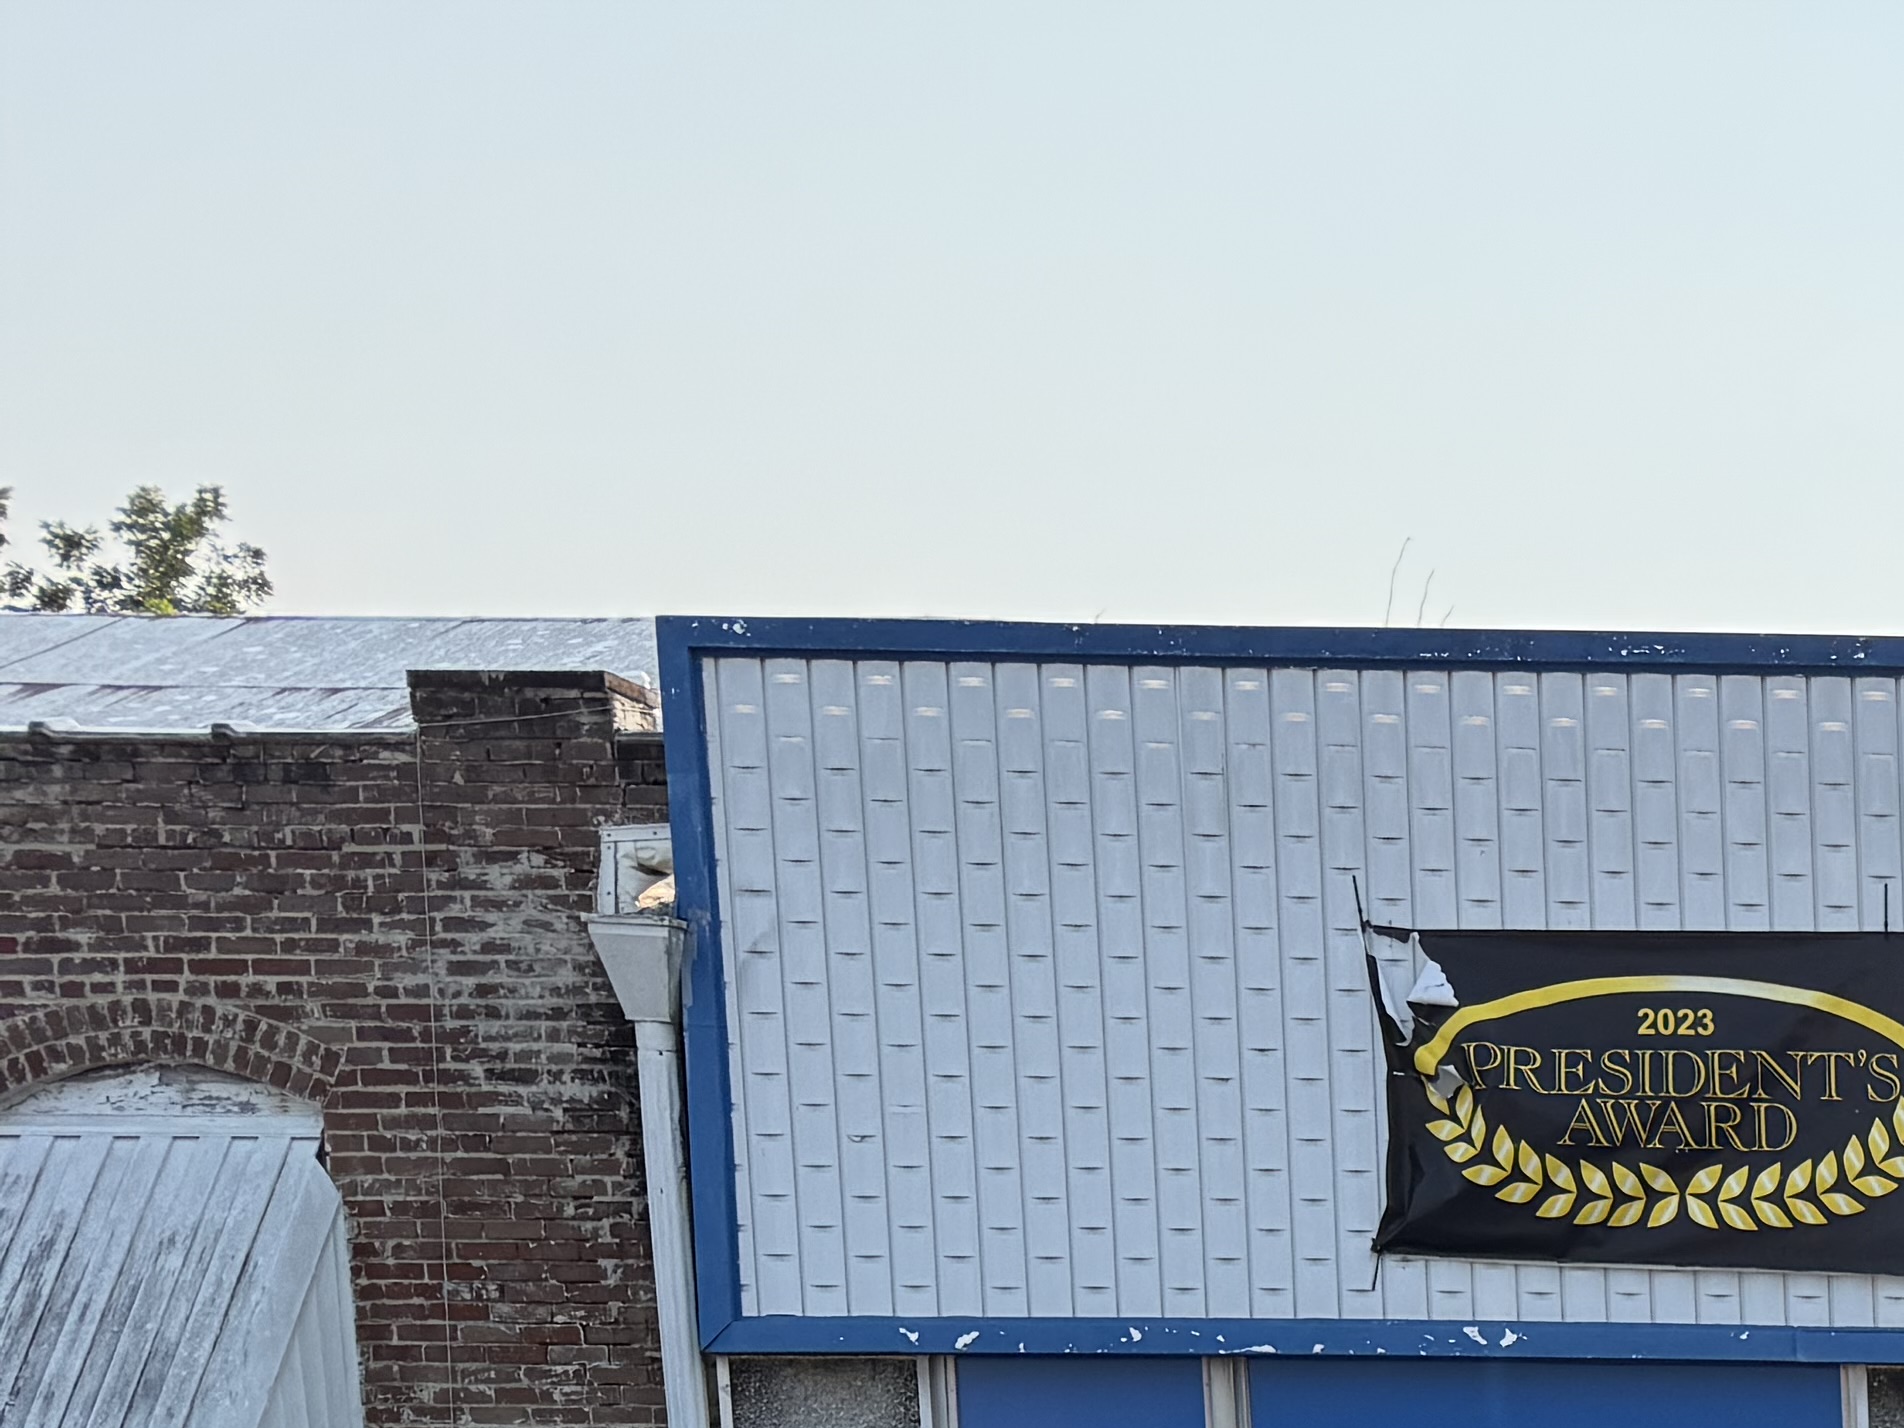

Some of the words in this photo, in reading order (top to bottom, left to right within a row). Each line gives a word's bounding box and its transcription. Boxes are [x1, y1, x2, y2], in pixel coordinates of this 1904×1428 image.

[1636, 1008, 1715, 1036] 2023
[1460, 1041, 1901, 1102] PRESIDENT'S
[1557, 1098, 1798, 1152] AWARD
